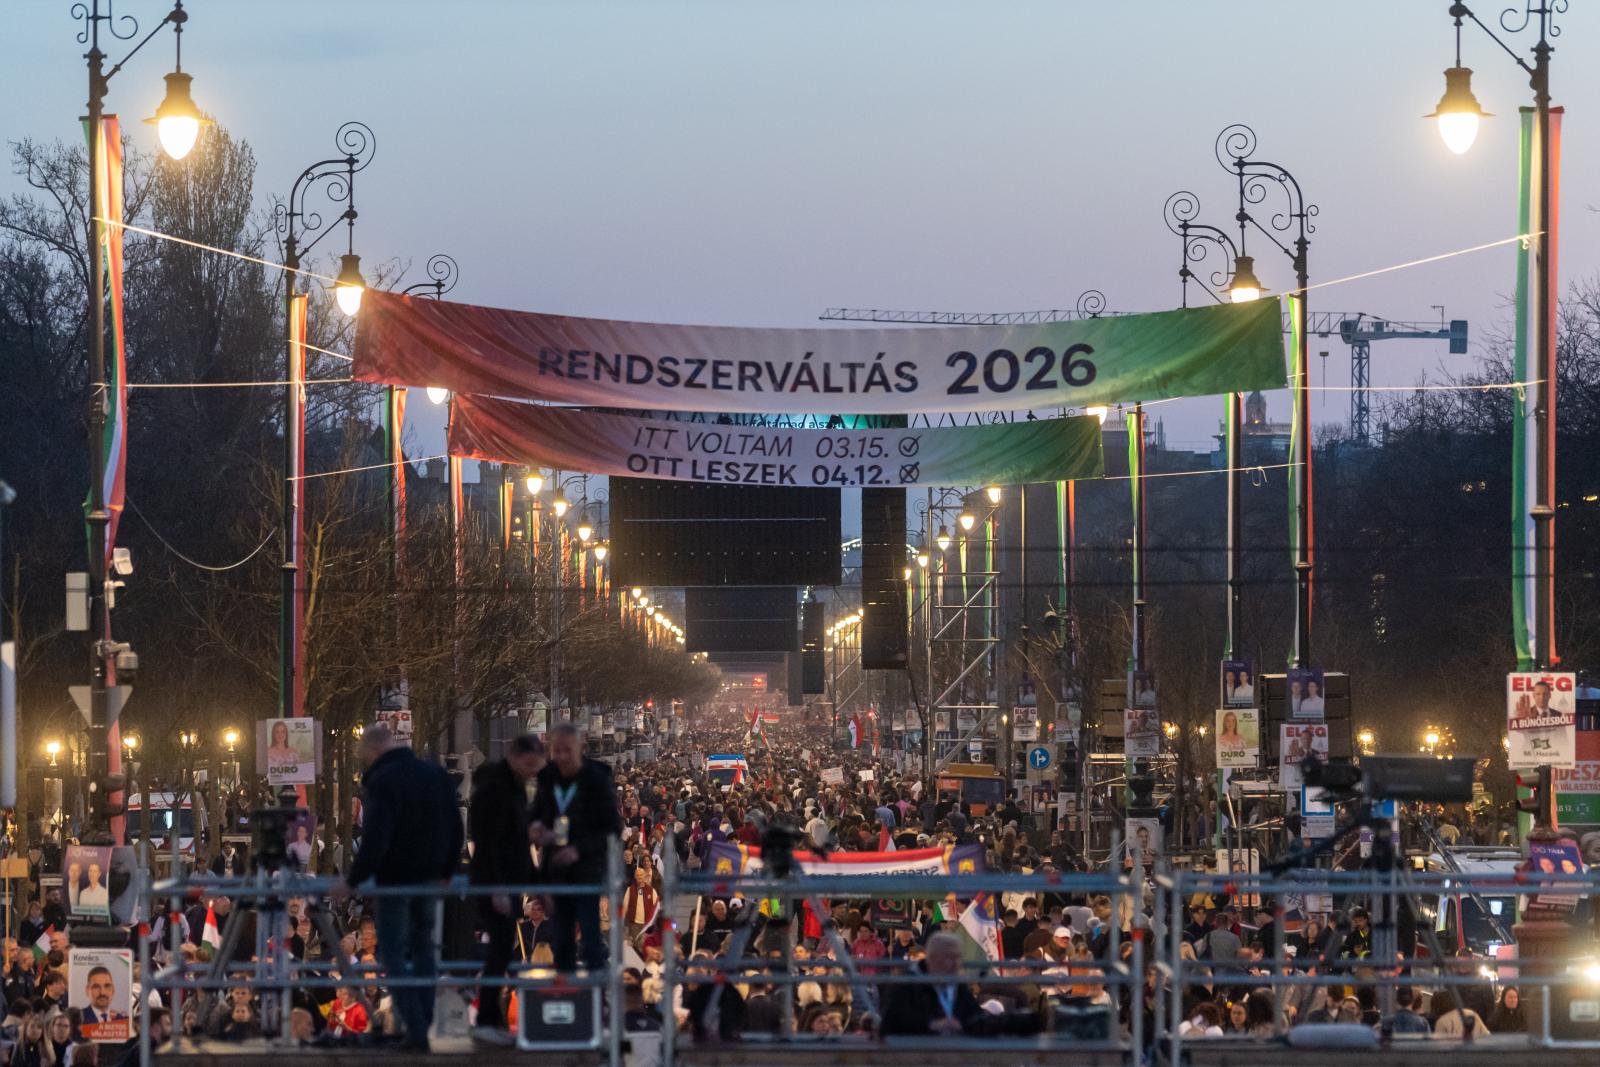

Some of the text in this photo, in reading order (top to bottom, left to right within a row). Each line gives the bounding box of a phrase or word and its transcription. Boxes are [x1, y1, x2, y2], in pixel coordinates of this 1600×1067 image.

[537, 343, 1097, 395] RENDSZERVÁLTÁS 2026
[633, 426, 889, 458] ITT VOLTAM 03.15.
[626, 454, 890, 486] OTT LESZEK 04.12.
[1512, 674, 1573, 692] ELÉG
[1128, 711, 1157, 719] ELG
